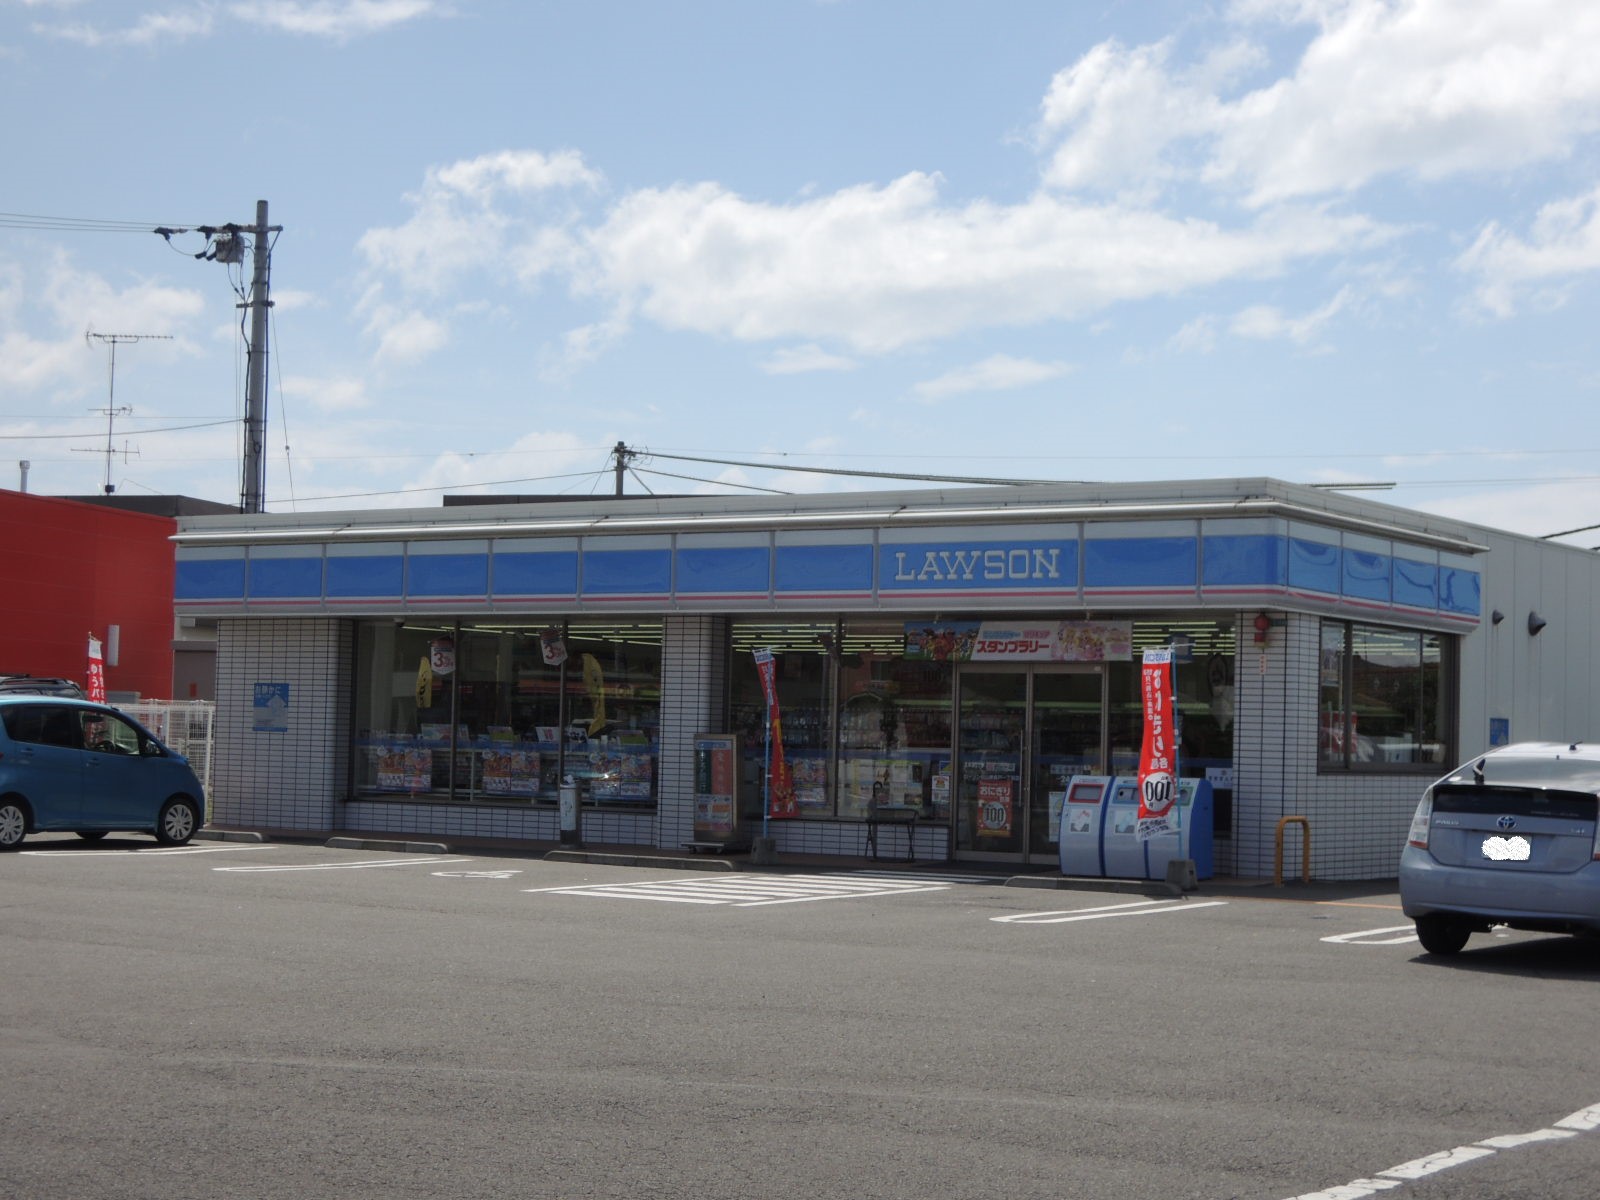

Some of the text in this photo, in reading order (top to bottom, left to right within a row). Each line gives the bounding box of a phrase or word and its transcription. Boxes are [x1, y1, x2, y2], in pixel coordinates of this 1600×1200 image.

[895, 549, 1060, 581] LAWSON
[977, 640, 1049, 653] スタンプラリー
[980, 786, 1010, 796] おにぎり
[985, 807, 1004, 822] 100
